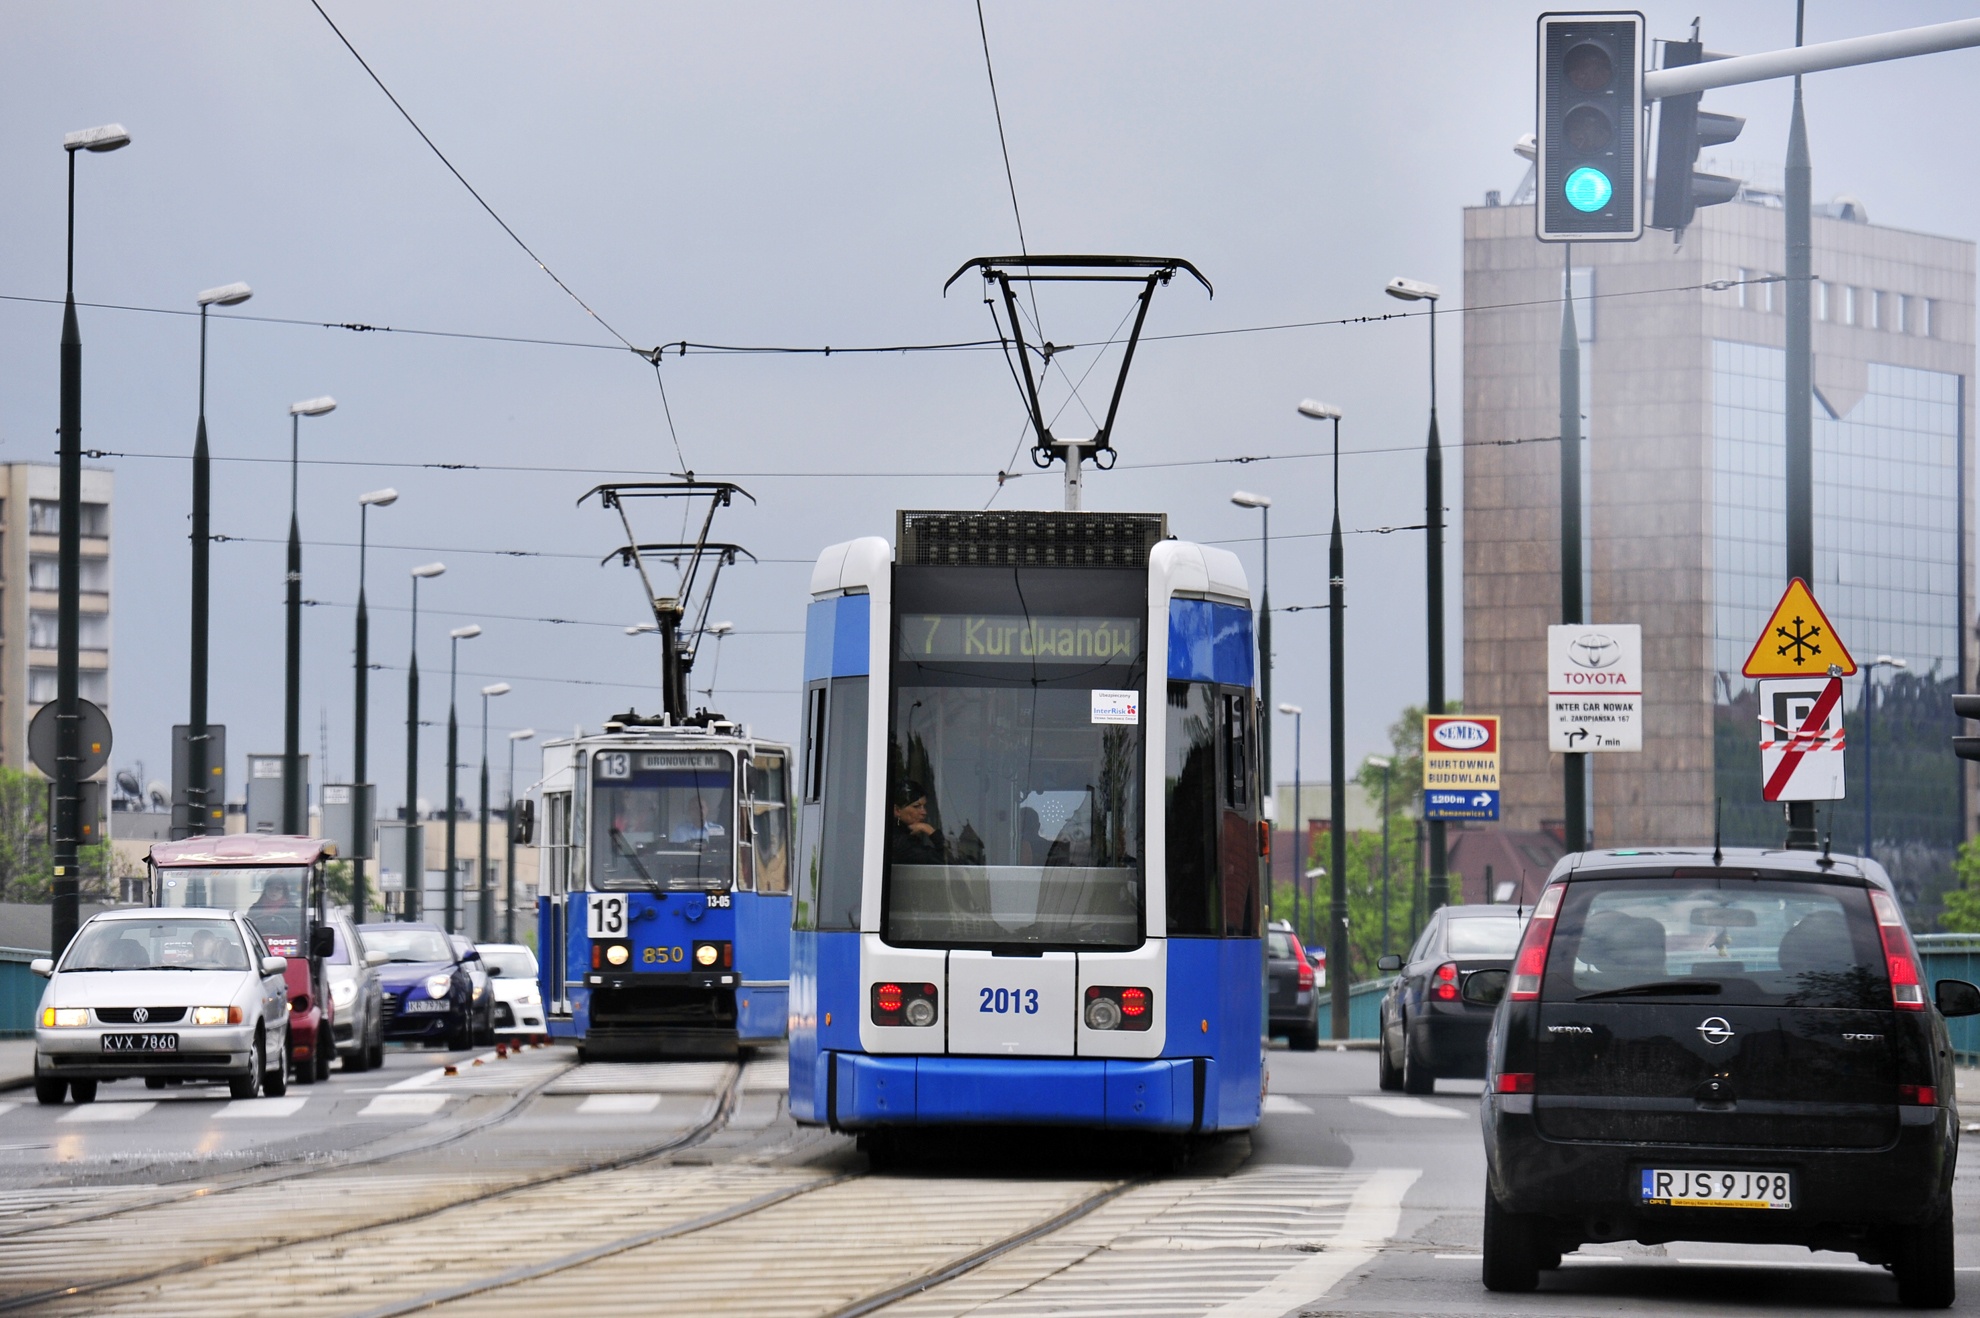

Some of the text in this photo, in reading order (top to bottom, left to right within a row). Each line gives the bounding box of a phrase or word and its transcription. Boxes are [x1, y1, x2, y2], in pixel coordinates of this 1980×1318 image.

[922, 616, 1131, 657] 7 Kurdwanów
[1564, 672, 1627, 685] TOYOTA
[1093, 707, 1126, 715] InterRisk
[1555, 703, 1634, 712] INTER CAR NOWAK
[1571, 714, 1616, 723] ZAKOPIAŃSKA
[1439, 725, 1484, 740] SEMEX
[1595, 734, 1621, 746] 7 min
[605, 753, 628, 776] 13
[647, 754, 701, 767] BRONOWICE
[1429, 760, 1495, 770] HURTOWNIA
[1428, 773, 1497, 784] BUDOWLANA
[706, 895, 731, 908] 13-05
[591, 898, 622, 934] 13
[268, 938, 297, 946] tours
[642, 946, 684, 964] 850
[979, 987, 1039, 1015] 2013
[103, 1034, 176, 1050] KVX 7860
[1643, 1187, 1652, 1195] PL
[1656, 1172, 1787, 1200] RJS 9J98
